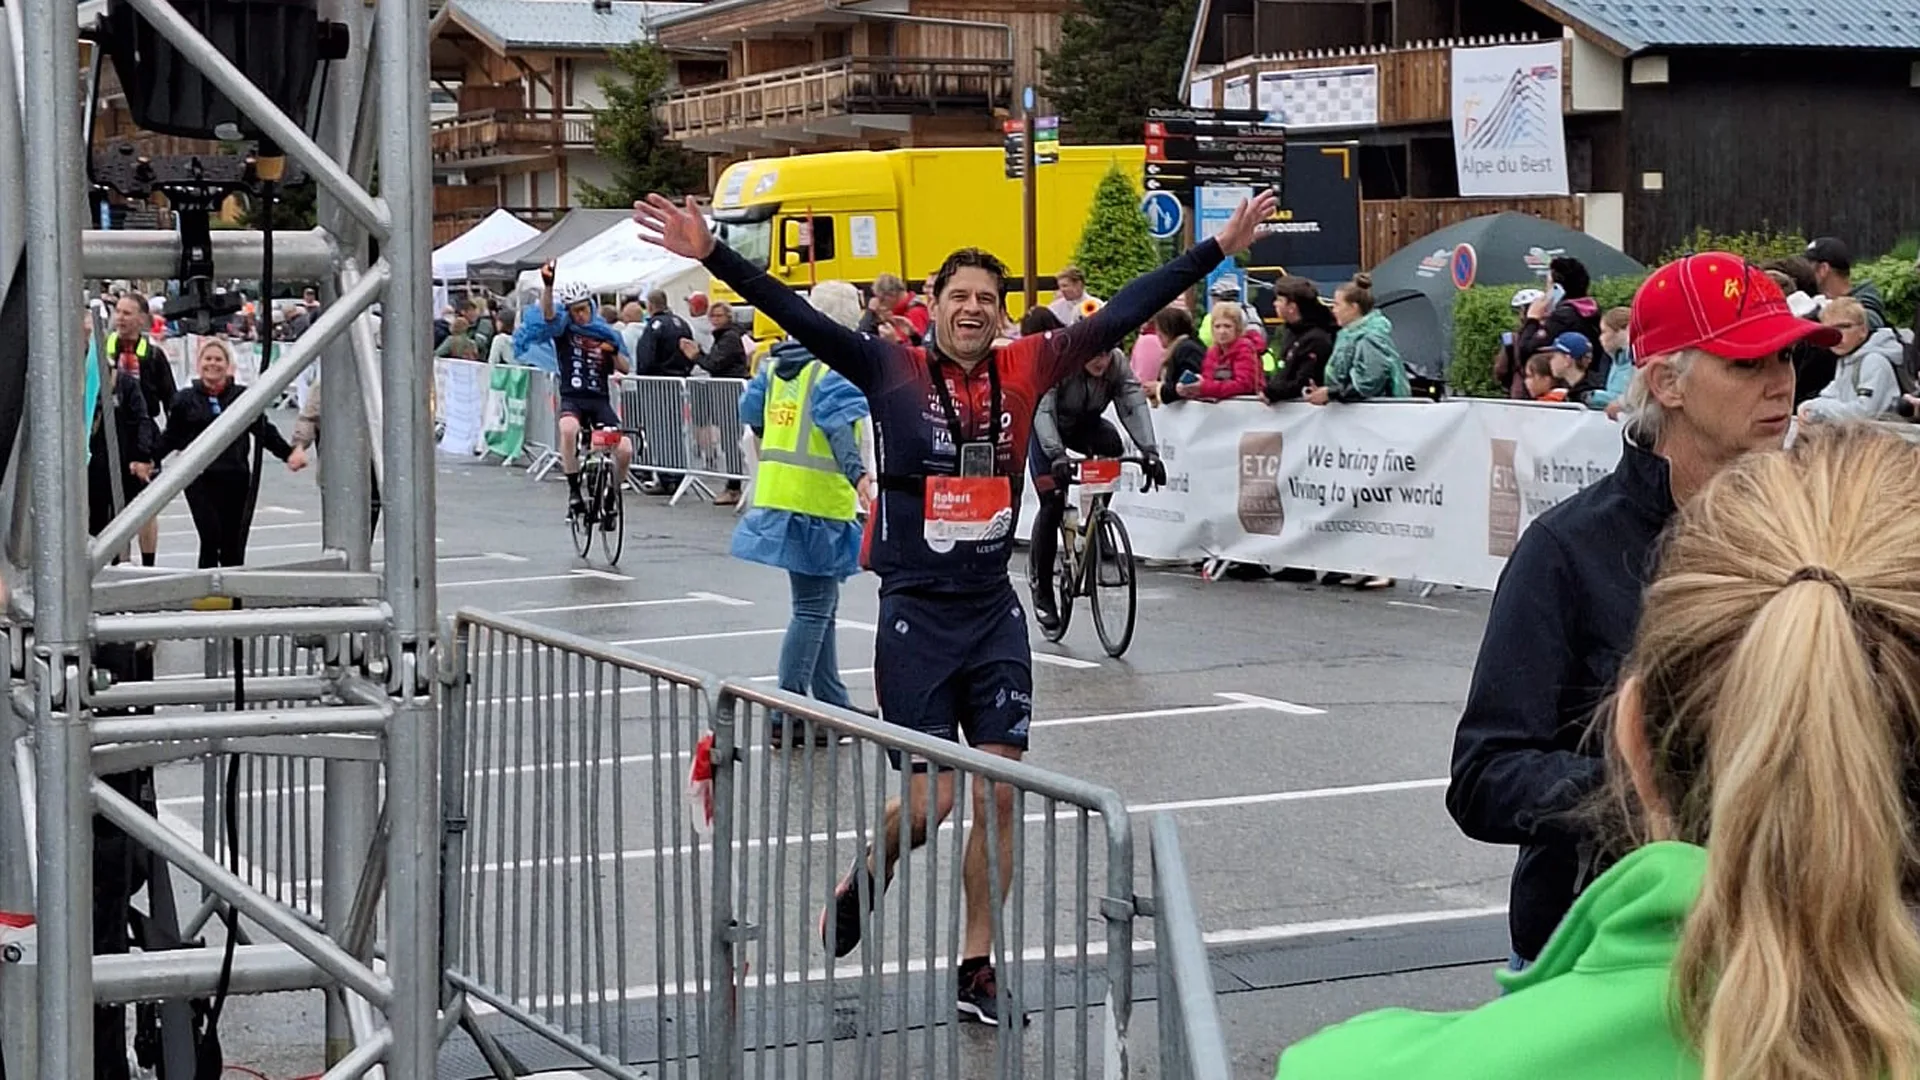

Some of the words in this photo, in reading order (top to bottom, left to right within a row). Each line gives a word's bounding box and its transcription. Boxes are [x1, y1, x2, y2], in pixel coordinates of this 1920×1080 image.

[1462, 155, 1493, 178] Alpe
[1496, 155, 1517, 173] du
[1520, 155, 1552, 173] Best
[1243, 455, 1279, 476] ETC
[1307, 445, 1334, 468] We
[1338, 446, 1379, 476] bring
[1382, 449, 1417, 472] fine
[1551, 457, 1584, 485] bring
[933, 490, 971, 504] Robert
[1288, 476, 1327, 507] living
[1331, 480, 1346, 502] to
[1352, 487, 1393, 508] your
[1399, 482, 1444, 506] world
